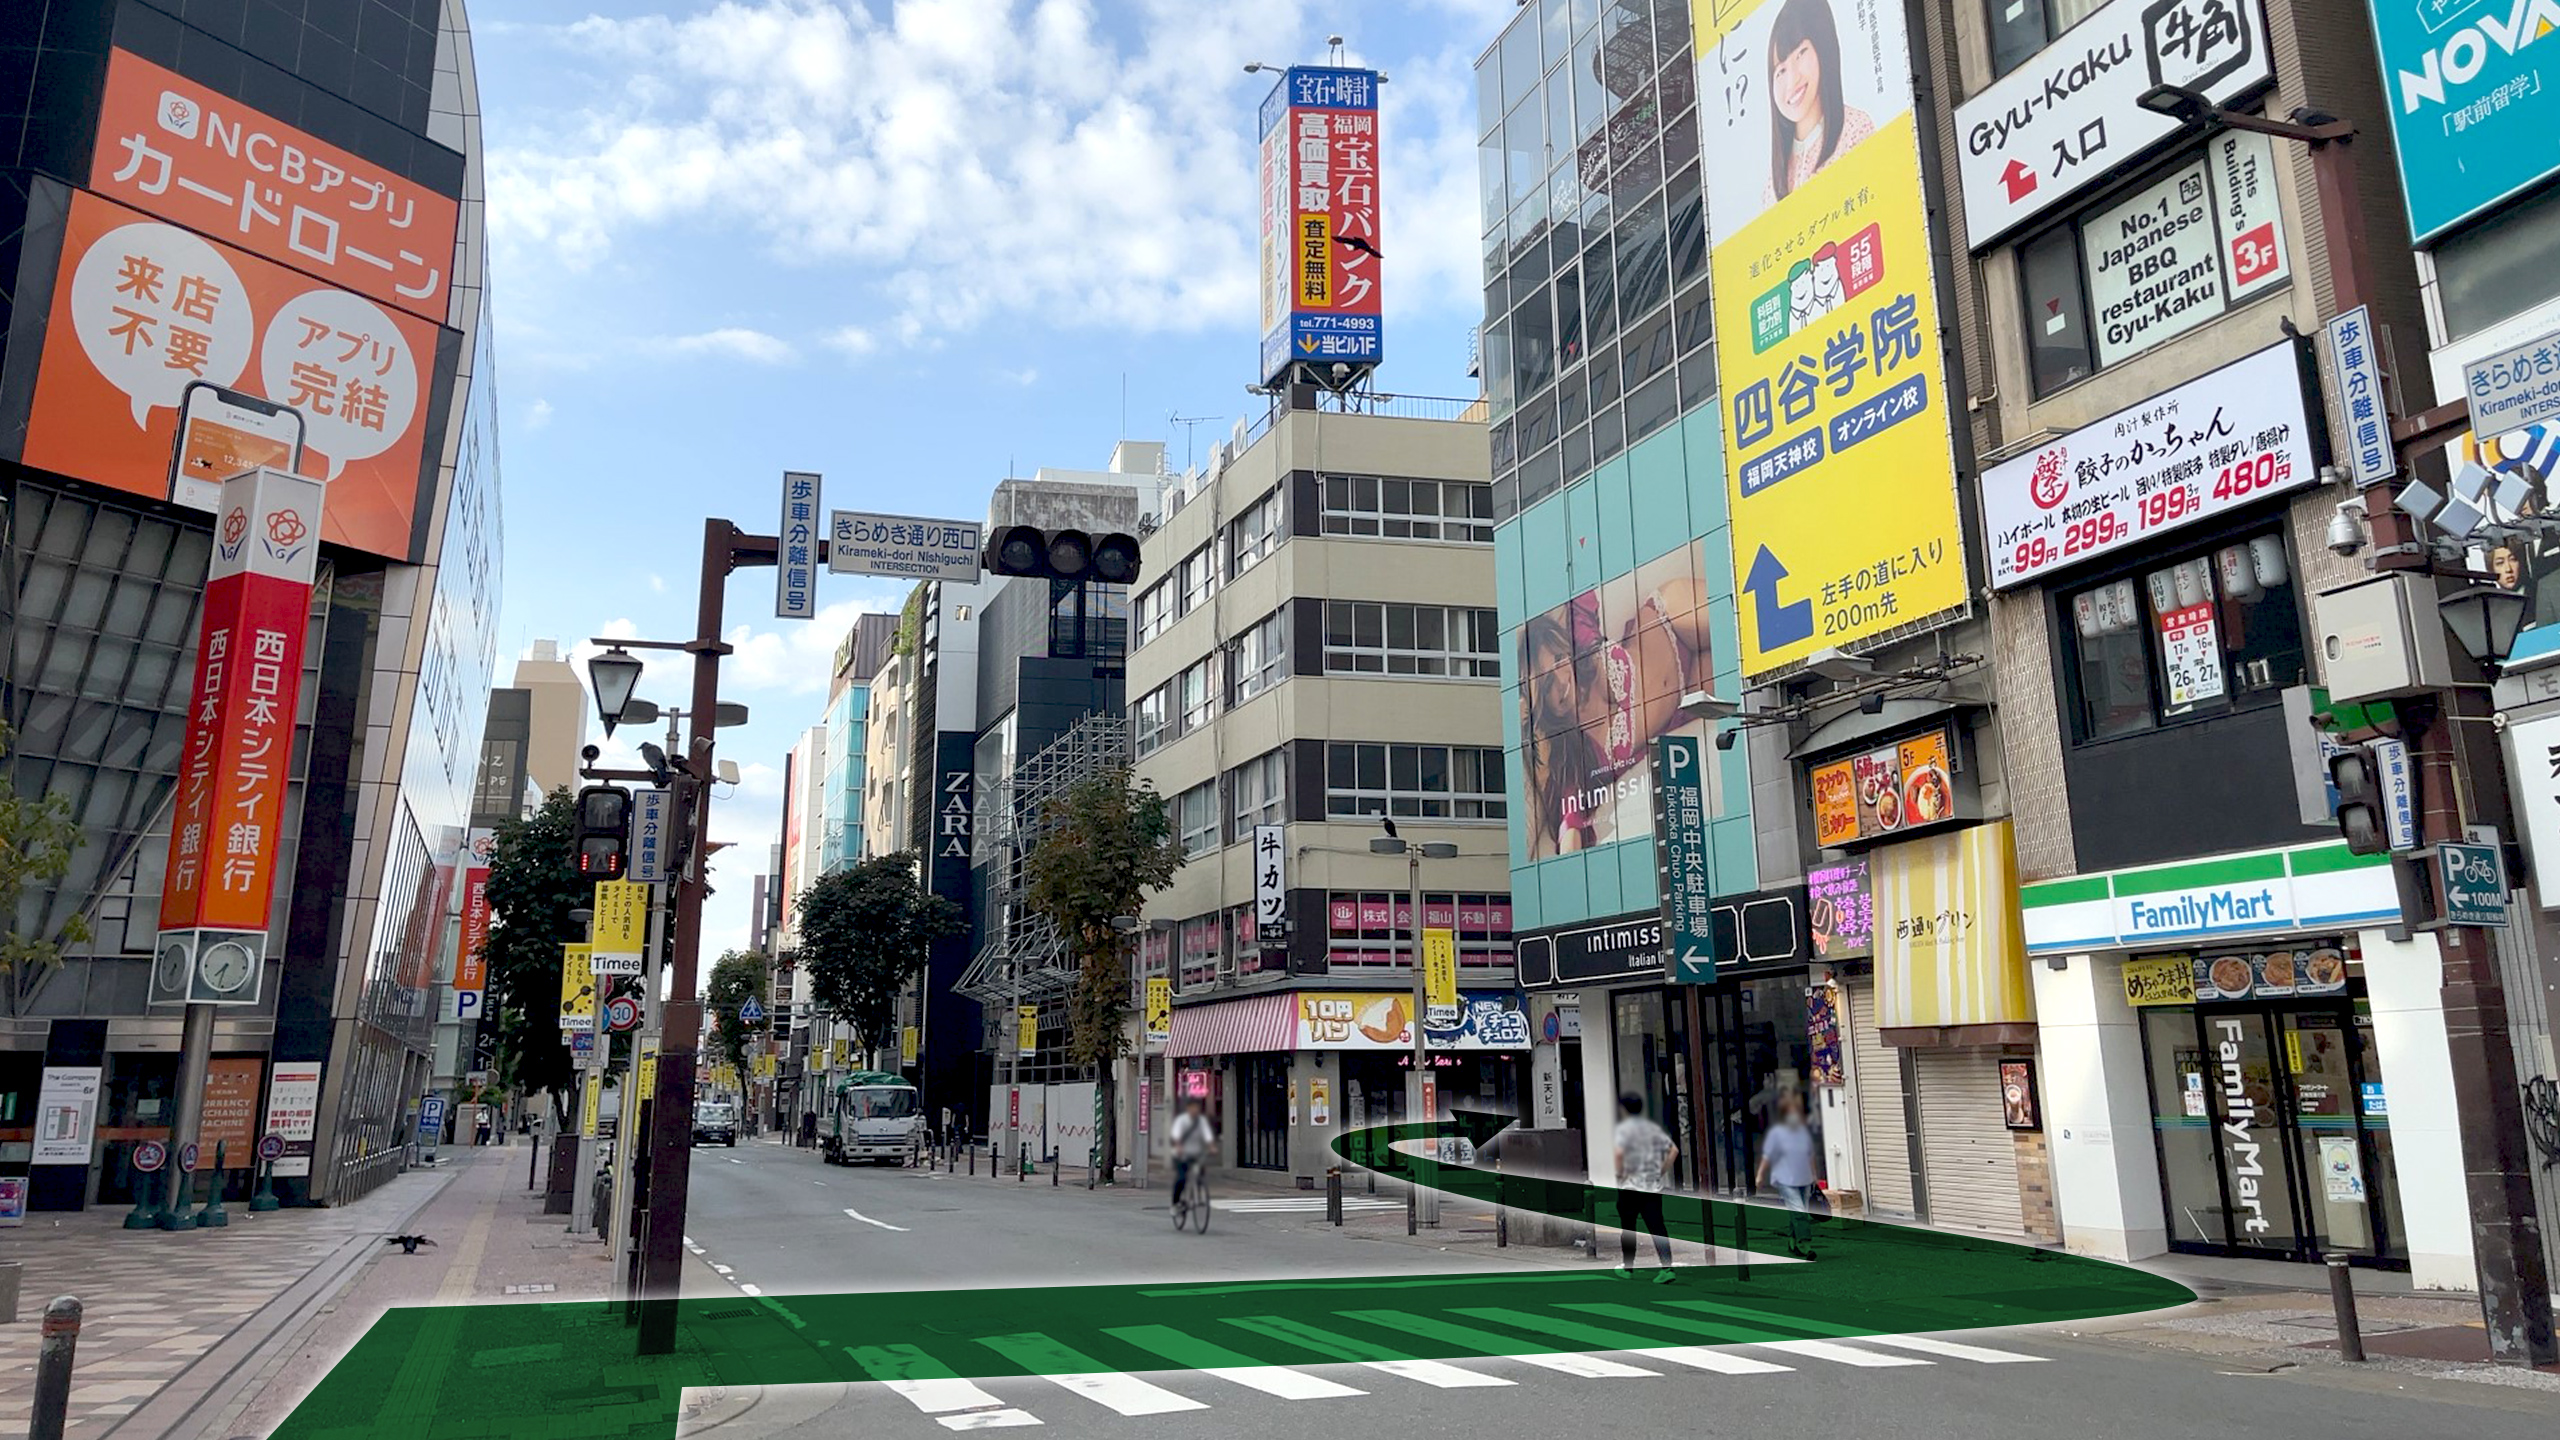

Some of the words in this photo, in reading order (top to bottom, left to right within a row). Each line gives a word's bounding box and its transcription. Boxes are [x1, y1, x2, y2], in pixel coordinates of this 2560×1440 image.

[2161, 0, 2239, 64] 牛角
[2399, 0, 2560, 115] NOVA
[1296, 75, 1369, 106] 宝石・時計
[1969, 33, 2133, 157] Gyu-Kaku
[2442, 69, 2541, 137] 「駅前留学」
[1333, 115, 1372, 135] 福岡
[2052, 116, 2107, 178] 入口
[205, 110, 415, 229] NCBアプリ
[1298, 112, 1330, 213] 高価買取
[2224, 138, 2245, 231] Building's
[2246, 154, 2256, 198] This
[113, 132, 440, 300] カードローン
[1335, 137, 1373, 309] 宝石バンク
[1749, 186, 1876, 279] 進化させるダブル教育。
[2121, 197, 2170, 239] No.1
[1305, 220, 1326, 301] 査定無料
[1851, 233, 1871, 262] 55
[2098, 205, 2203, 273] Japanese
[2237, 240, 2273, 275] 3F
[1851, 254, 1873, 279] 段階
[2102, 252, 2214, 324] restaurant
[2128, 246, 2178, 286] BBQ
[115, 254, 221, 324] 来店
[1757, 294, 1781, 320] 科目別
[1758, 309, 1782, 335] 能力別
[2107, 281, 2215, 345] Gyu-Kaku
[108, 305, 211, 378] 不要
[297, 315, 396, 379] アプリ
[1322, 335, 1376, 355] 当ビル1F
[1734, 294, 1922, 450] 四谷学院
[286, 362, 391, 433] 完結
[1837, 386, 1918, 443] オンライン校
[2338, 320, 2383, 474] 歩車分離信号
[2521, 396, 2560, 418] INTERS
[1747, 438, 1817, 489] 福岡天神校
[2075, 406, 2235, 489] 餃子のかっちゃん
[2213, 452, 2291, 501] 480円
[1998, 513, 2055, 548] ハイボール
[2062, 485, 2130, 523] 本物の生ビール
[2138, 486, 2201, 531] 199円
[786, 480, 811, 611] 歩車分離信号
[836, 519, 976, 550] きらめき通り西口
[838, 545, 913, 562] Kirameki-dori
[918, 551, 973, 566] Nishiguchi
[2015, 537, 2058, 574] 99円
[2064, 512, 2128, 557] 299円
[871, 561, 939, 574] INTERSECTION
[1821, 538, 1944, 606] 左手の道に入り
[1824, 592, 1898, 636] 200m先
[2166, 607, 2208, 628] 営業時間
[176, 629, 229, 892] 西日本シティ銀行
[223, 629, 286, 892] 西日本シティ銀行
[1668, 744, 1690, 778] P
[1903, 748, 1914, 766] 5F
[939, 772, 970, 857] ZARA
[1562, 775, 1646, 815] intimissi
[1666, 785, 1678, 840] Fukuoka
[641, 793, 660, 878] 歩車分離信号
[1260, 832, 1281, 916] 牛カツ
[1670, 845, 1681, 879] Chuo
[1680, 787, 1709, 938] 福岡中央駐車場
[2445, 848, 2466, 882] P
[1674, 883, 1685, 932] Parking
[2131, 888, 2274, 930] FamilyMart
[2471, 892, 2502, 907] 100M
[463, 883, 485, 981] 西日本シティ銀行
[1587, 926, 1661, 953] intimiss
[1896, 910, 1976, 939] 西通りプリン
[594, 956, 640, 970] Timee
[1629, 953, 1657, 968] Italian
[2127, 962, 2192, 999] めちゃうま丼
[458, 992, 477, 1016] P
[561, 1018, 591, 1026] Timee
[613, 1007, 631, 1020] 30
[1305, 999, 1354, 1021] 10円
[1428, 1007, 1455, 1016] Timee
[1474, 1001, 1503, 1012] NEW
[1311, 1021, 1350, 1042] パン
[1480, 1026, 1525, 1044] チュロス
[429, 1103, 438, 1115] P
[2214, 1019, 2270, 1233] FamilyMart
